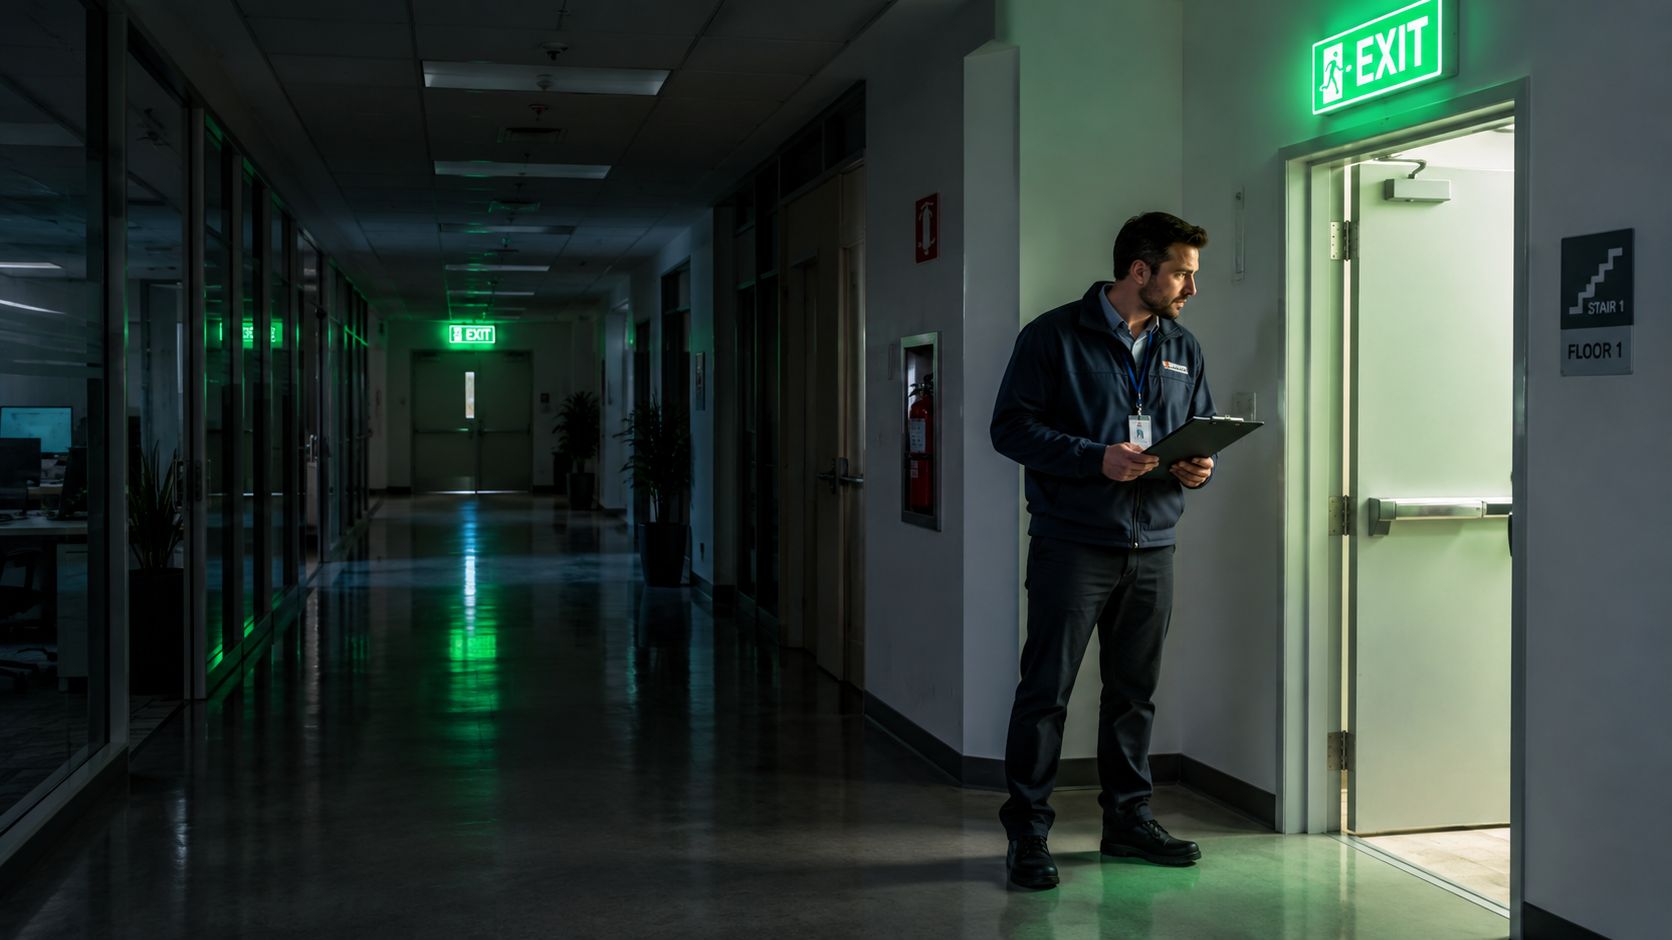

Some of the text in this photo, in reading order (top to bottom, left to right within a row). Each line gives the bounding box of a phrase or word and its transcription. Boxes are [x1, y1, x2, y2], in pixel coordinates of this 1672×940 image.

[1356, 15, 1429, 87] EXIT
[1587, 300, 1625, 315] STAIR 1
[465, 328, 492, 341] EXIT
[1567, 341, 1623, 360] FLOOR 1
